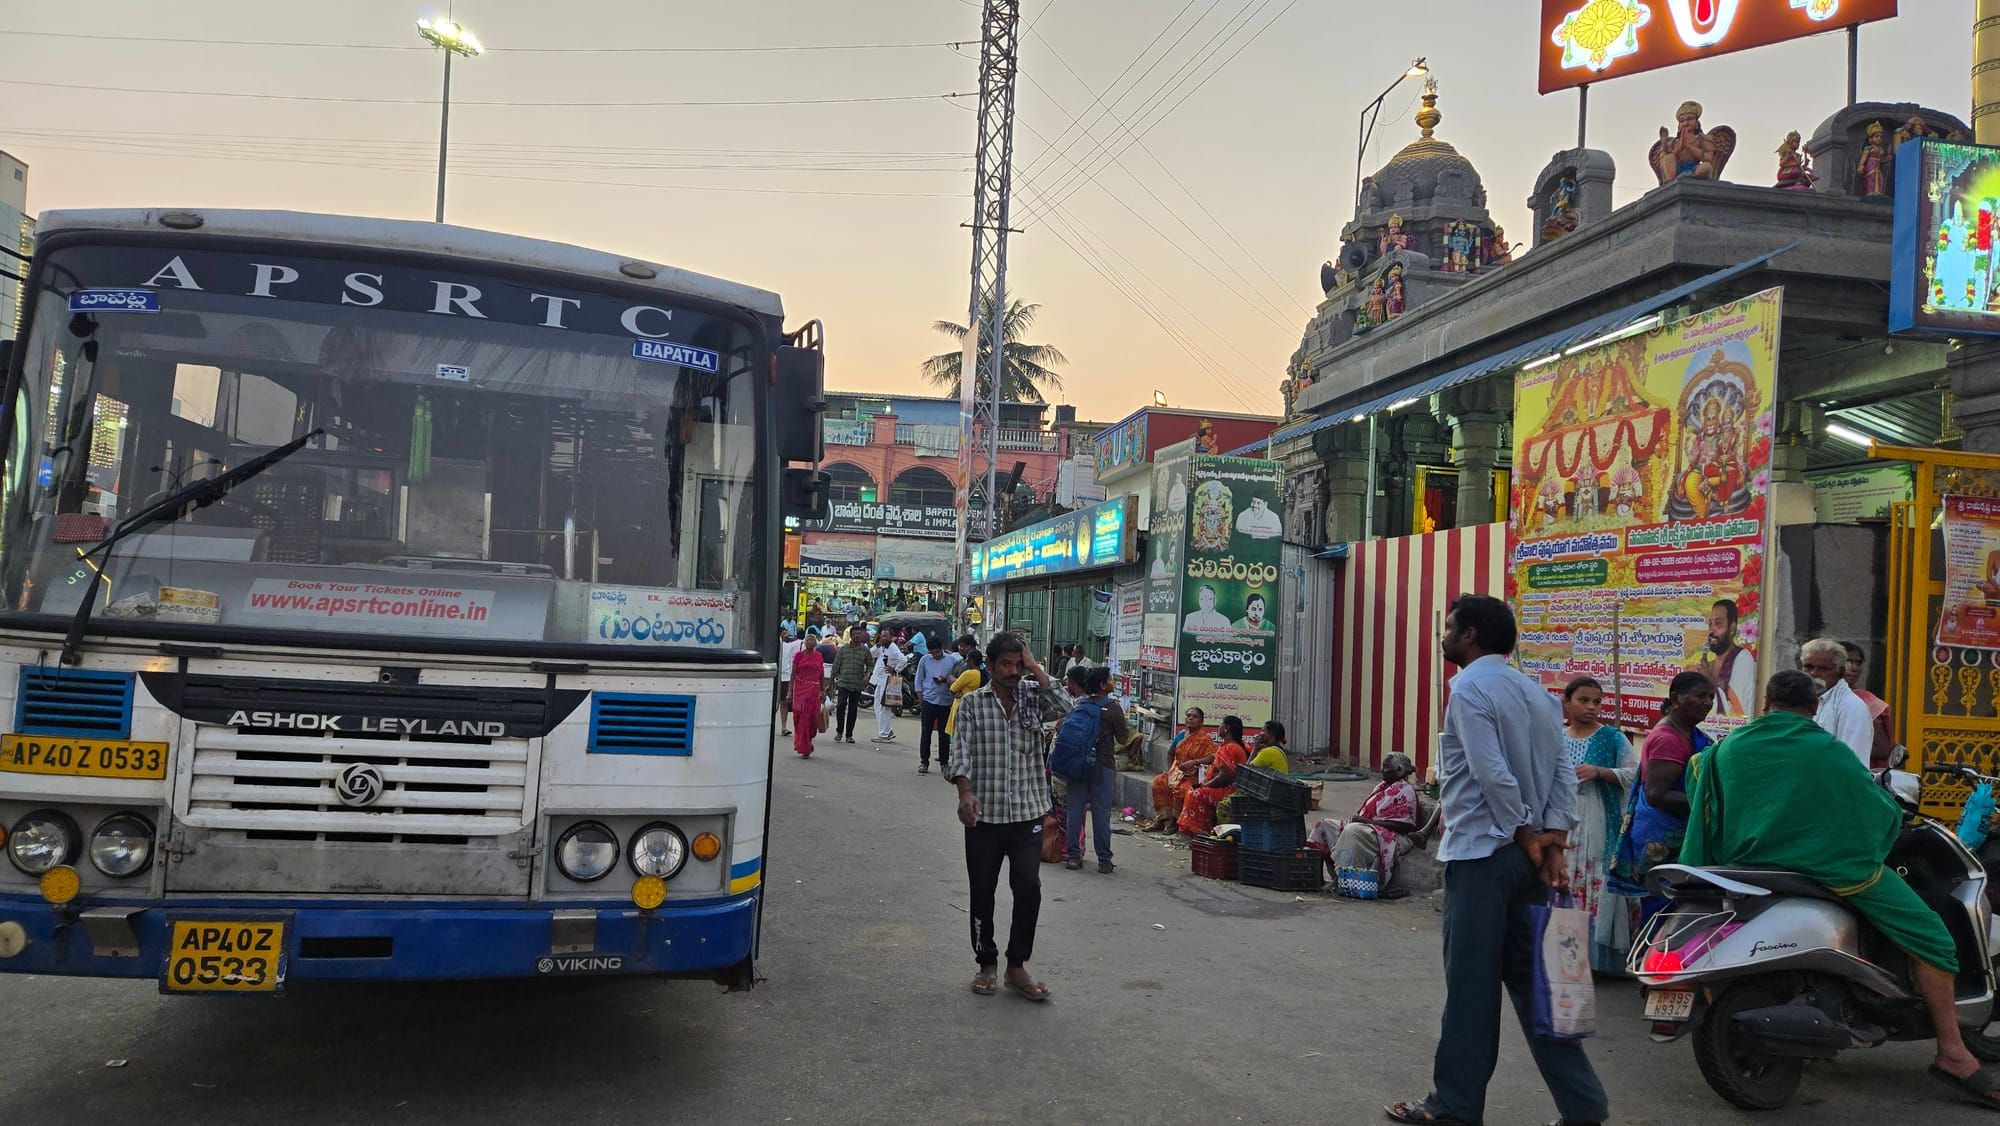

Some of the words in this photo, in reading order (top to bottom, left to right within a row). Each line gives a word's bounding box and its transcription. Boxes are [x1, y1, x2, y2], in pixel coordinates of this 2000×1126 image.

[80, 291, 147, 309] బాపట్ల
[641, 342, 713, 369] BAPATLA
[833, 502, 861, 523] బాపట్ల
[863, 504, 884, 520] దంత
[925, 507, 958, 518] BAPATL
[800, 562, 843, 577] మందుల
[845, 564, 872, 579] షాపు
[1187, 555, 1278, 588] చలివేంద్రం
[288, 580, 322, 590] Book
[329, 583, 358, 592] Your
[364, 585, 414, 596] Tickets
[418, 588, 462, 598] Online
[592, 590, 627, 605] బాపట్ల
[251, 592, 487, 621] www.apsrtconline.in
[600, 610, 725, 644] గుంటూరు
[1576, 629, 1584, 645] శ్రీ
[1565, 658, 1590, 674] శ్రీవారి
[227, 710, 342, 731] ASHOK
[361, 716, 506, 737] LEYLAND
[14, 742, 73, 768] AP40
[77, 746, 92, 768] Z
[100, 748, 161, 772] 0533
[181, 928, 274, 952] AP40Z
[1749, 940, 1798, 957] fascino
[174, 956, 267, 986] 0533
[557, 958, 622, 971] VIKING
